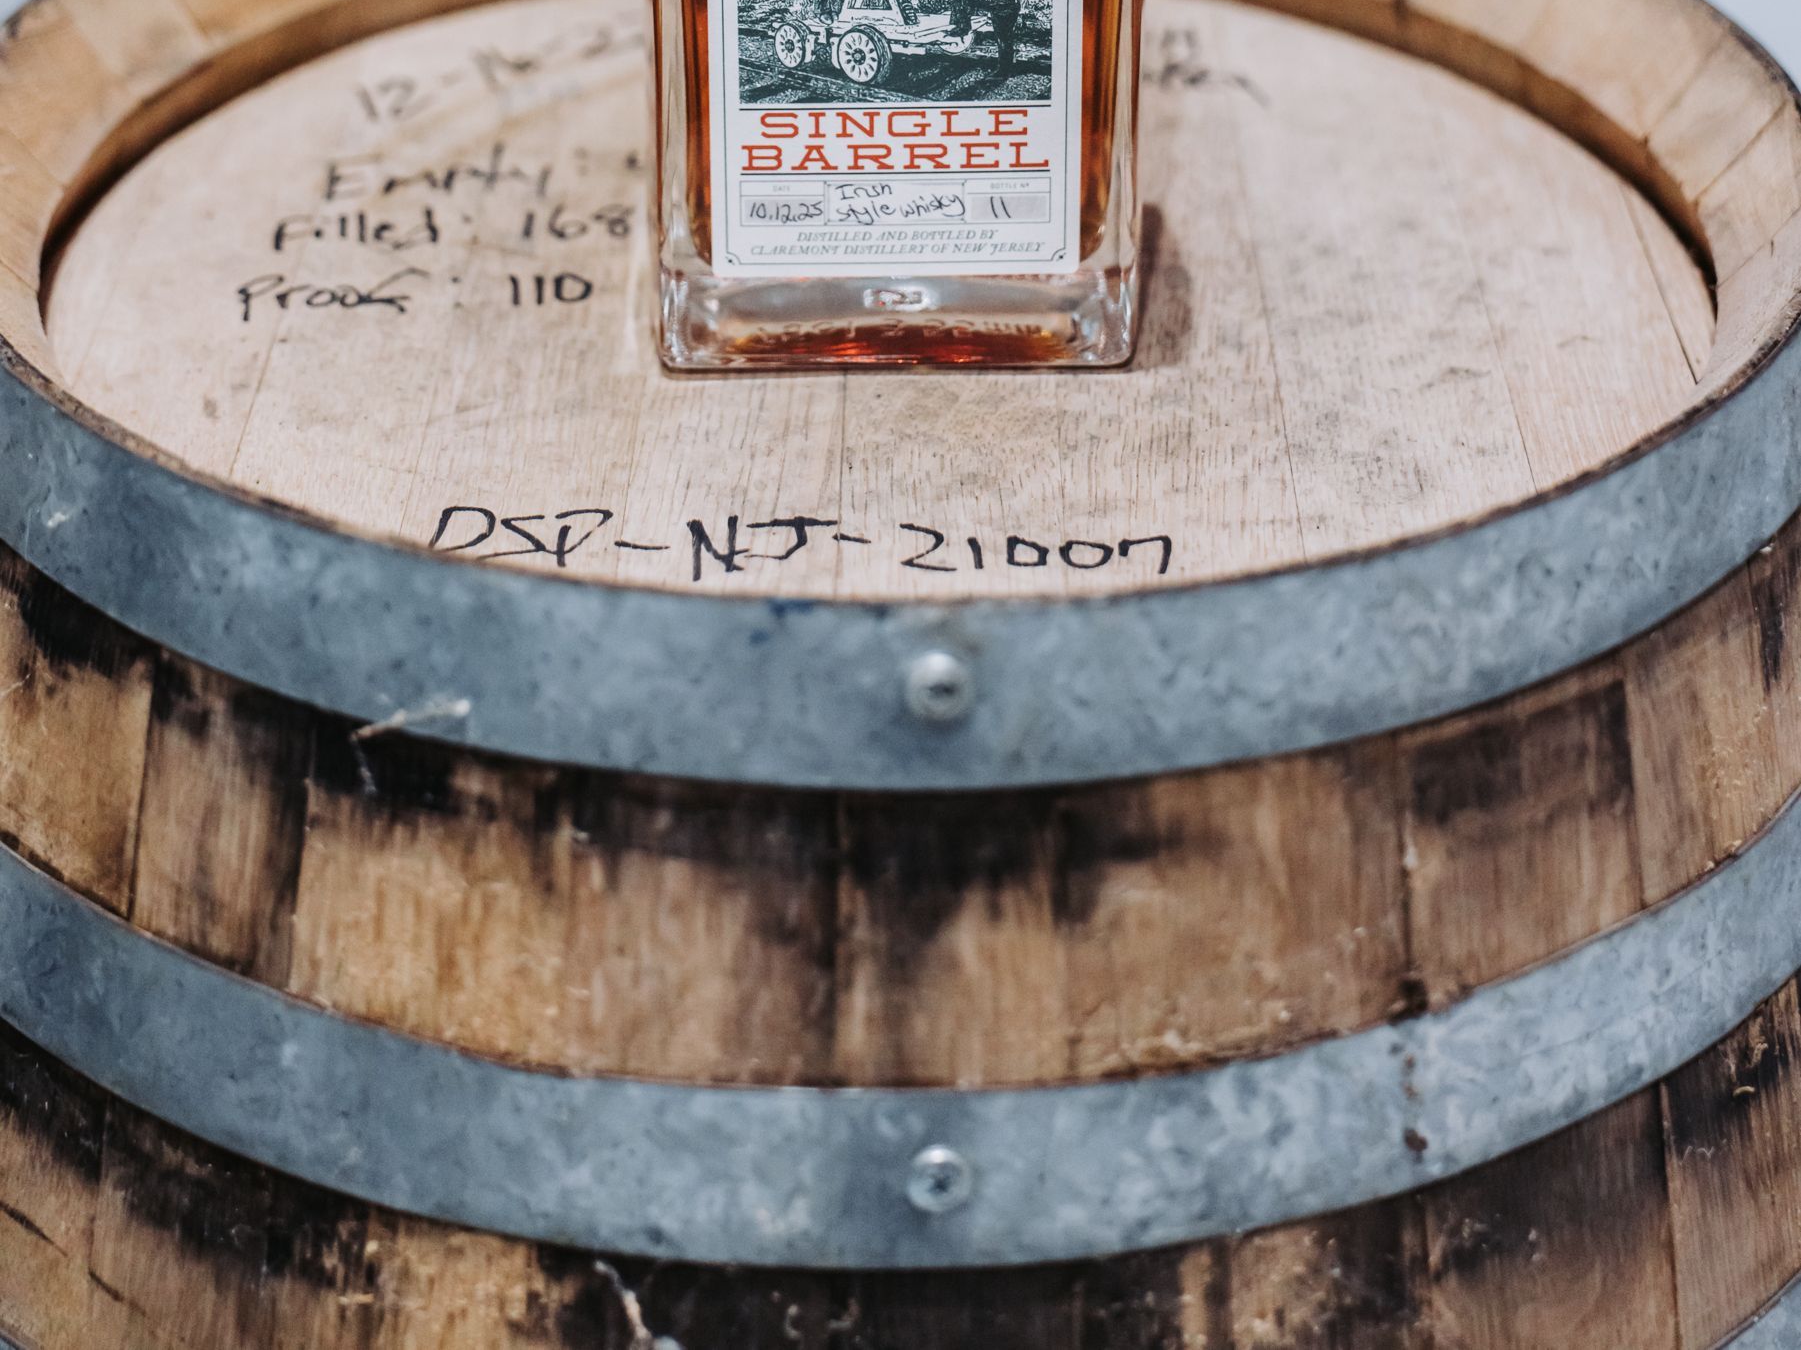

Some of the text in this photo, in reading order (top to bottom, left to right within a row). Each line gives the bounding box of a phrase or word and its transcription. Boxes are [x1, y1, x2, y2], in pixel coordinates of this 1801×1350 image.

[759, 109, 1029, 140] SINGLE
[741, 142, 1050, 172] BARREL
[750, 245, 840, 256] CLAREMONT
[508, 271, 593, 307] 110
